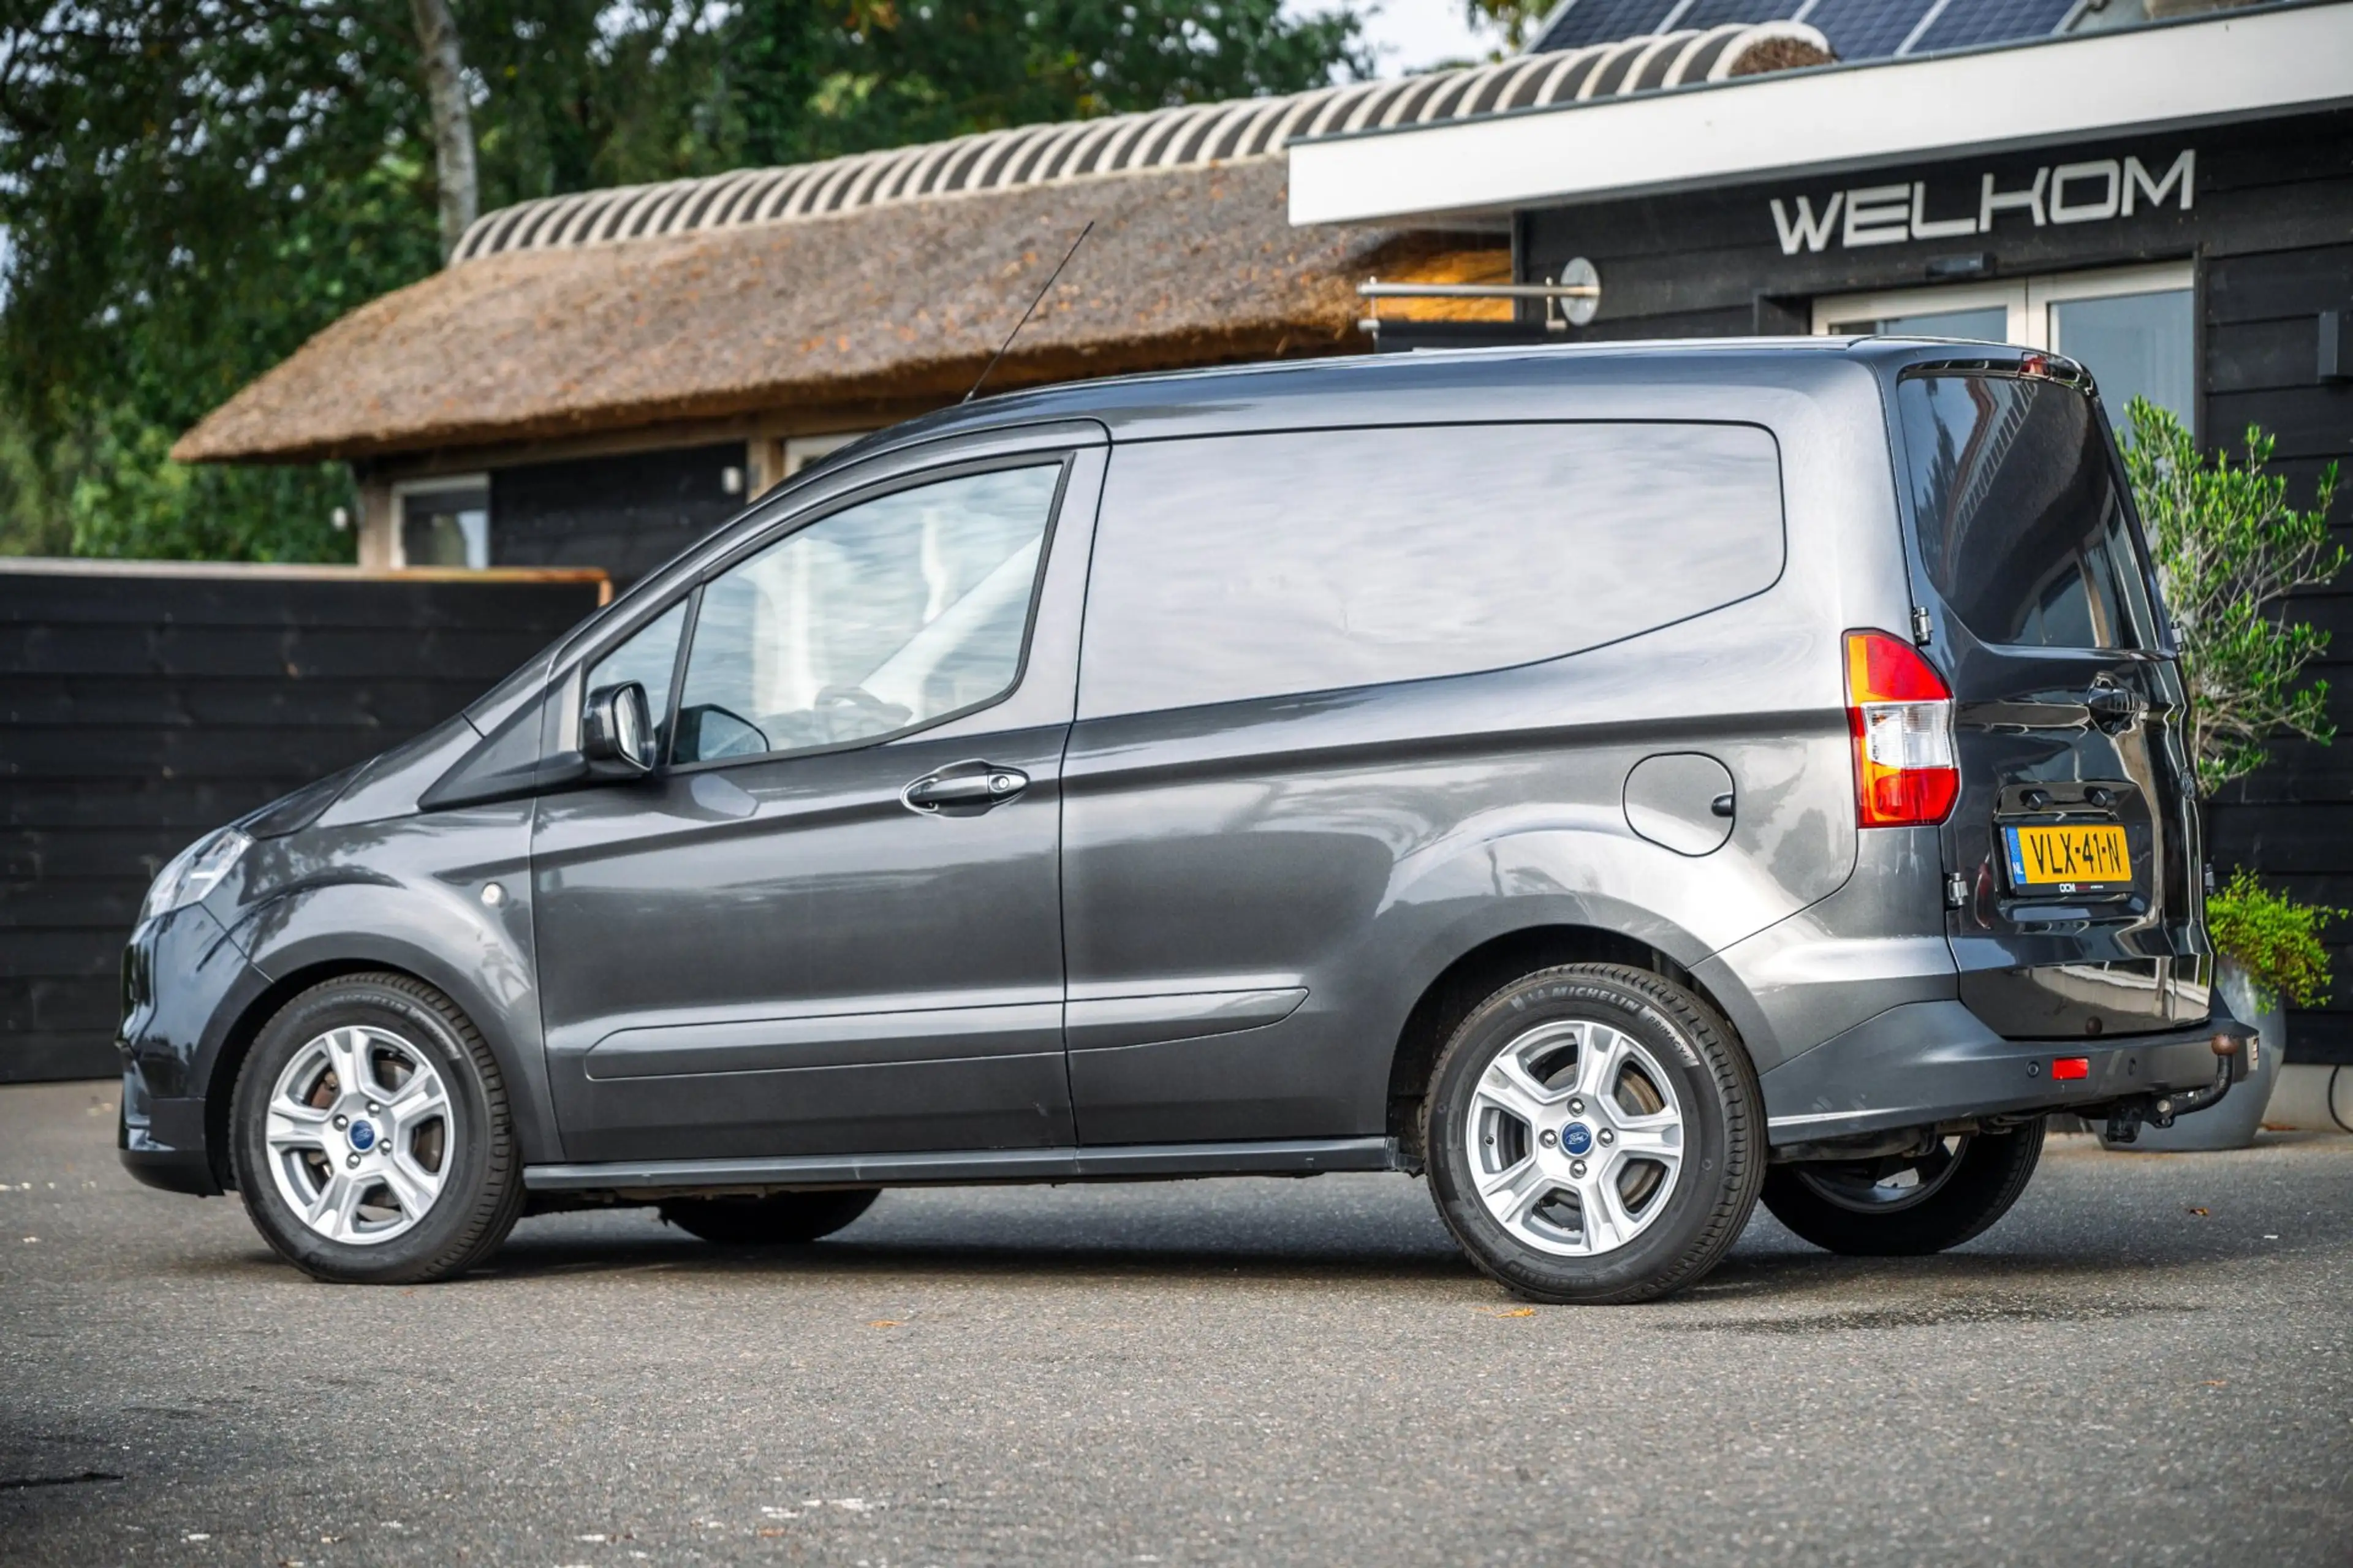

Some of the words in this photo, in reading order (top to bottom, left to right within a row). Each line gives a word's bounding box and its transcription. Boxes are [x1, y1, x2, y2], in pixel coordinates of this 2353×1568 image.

[1770, 149, 2196, 255] WELKOM
[2012, 862, 2024, 875] NL
[2029, 833, 2121, 875] VLX-41-N
[1552, 986, 1642, 1011] MICHELIN
[1646, 1016, 1686, 1053] PRIMACY
